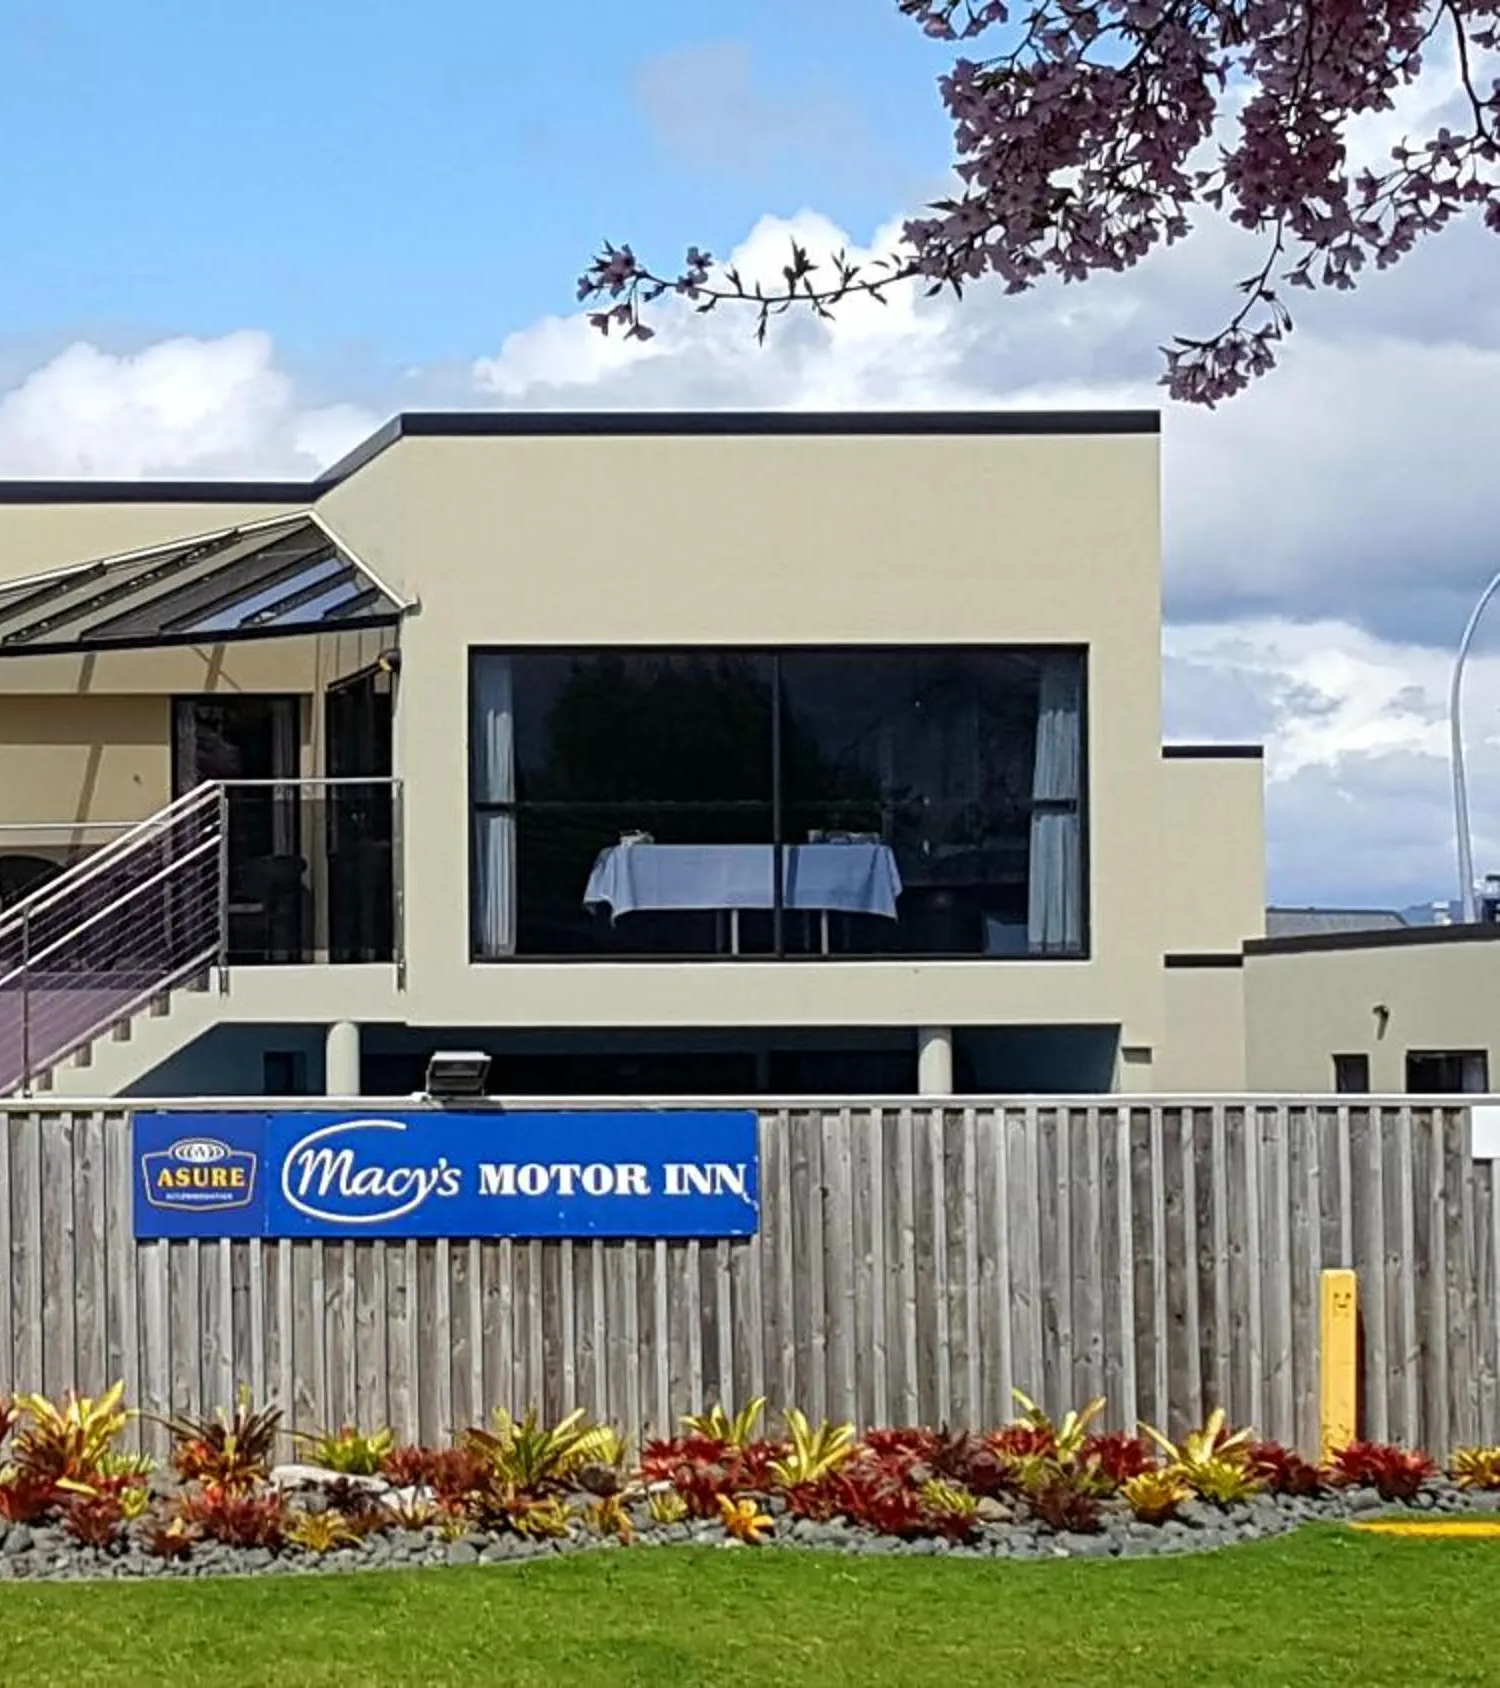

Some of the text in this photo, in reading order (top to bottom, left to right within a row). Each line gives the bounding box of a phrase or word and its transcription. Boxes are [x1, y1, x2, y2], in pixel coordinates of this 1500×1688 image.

[157, 1167, 245, 1188] ASURE
[284, 1140, 747, 1221] Macy's MOTOR INN
